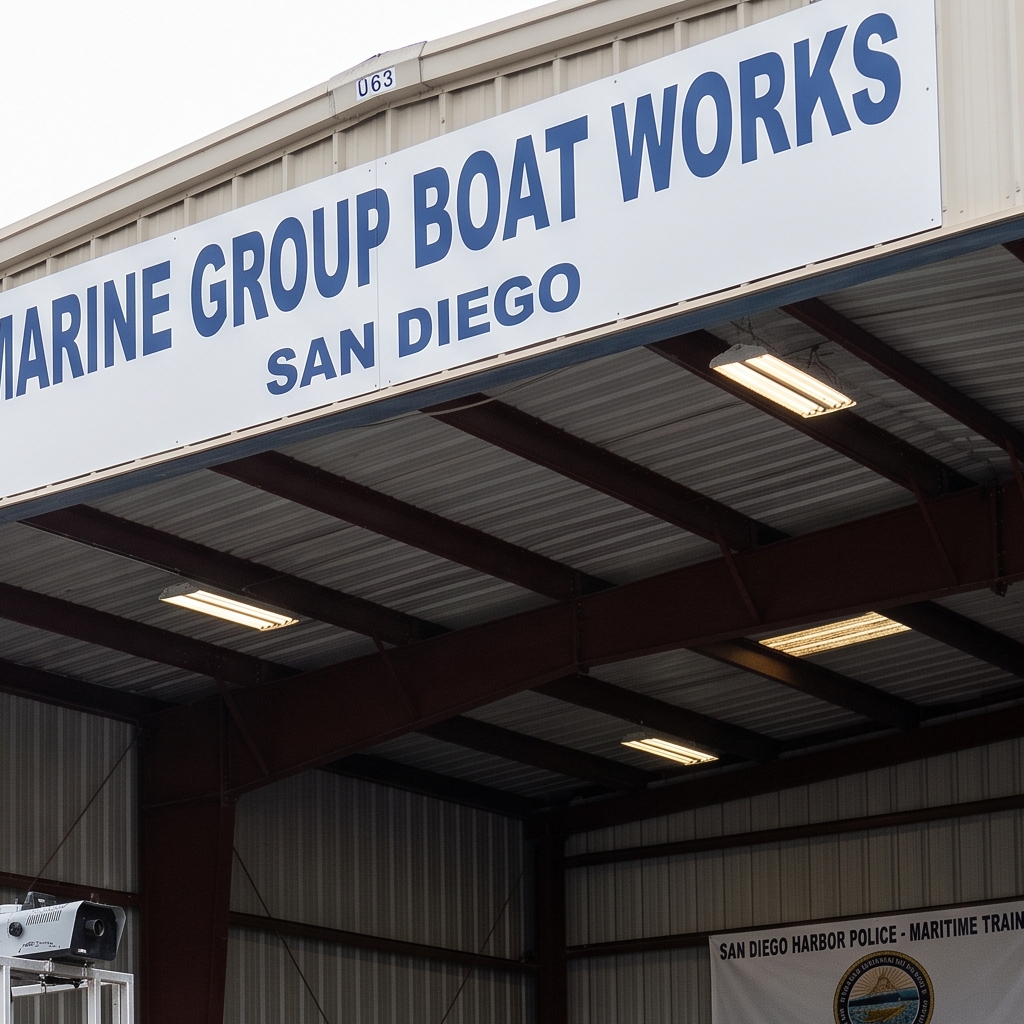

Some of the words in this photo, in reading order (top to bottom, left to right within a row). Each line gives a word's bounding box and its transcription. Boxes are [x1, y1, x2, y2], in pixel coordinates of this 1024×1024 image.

[191, 189, 391, 338] GROUP
[413, 116, 589, 269] BOAT
[611, 13, 902, 202] WORKS
[267, 323, 376, 396] SAN
[398, 263, 581, 358] DIEGO
[719, 941, 746, 960] SAN
[749, 937, 788, 958] DIEGO
[792, 931, 846, 953] HARBOR
[849, 925, 897, 947] POLICE
[909, 916, 978, 941] MARITIME
[981, 911, 1024, 934] TRAIN
